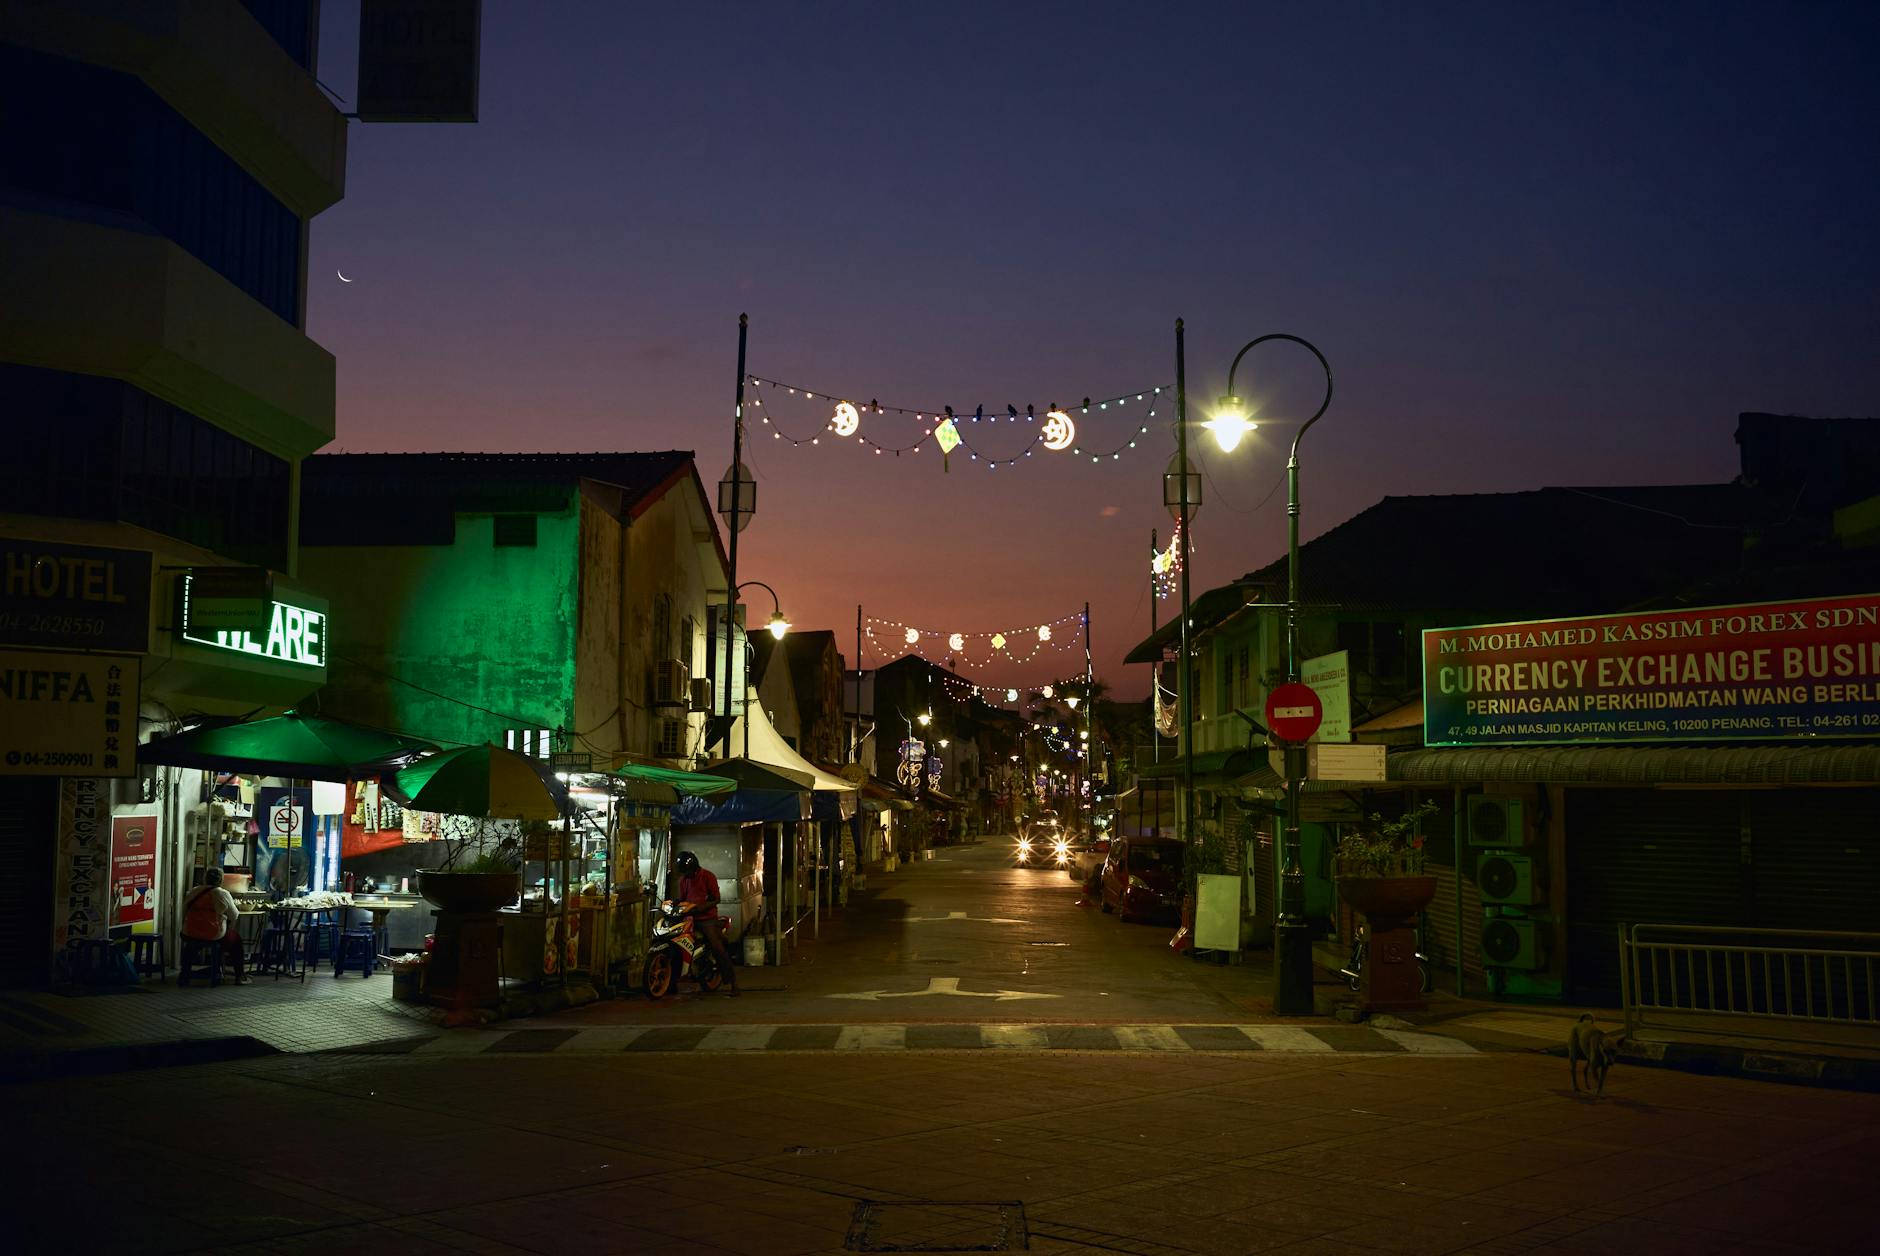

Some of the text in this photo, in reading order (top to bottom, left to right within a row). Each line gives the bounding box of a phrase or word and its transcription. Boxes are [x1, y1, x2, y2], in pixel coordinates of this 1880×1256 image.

[5, 552, 128, 606] HOTEL
[265, 603, 320, 665] ARE
[1602, 619, 1703, 643] KASSIM
[1710, 611, 1808, 636] FOREX
[1815, 606, 1879, 629] SDN
[1440, 658, 1588, 694] CURRENCY
[1598, 648, 1772, 687] EXCHANGE
[1466, 695, 1579, 716] PERNIAGAAN
[1584, 688, 1737, 711] PERKHIDMATAN
[1742, 685, 1808, 705] WANG
[1465, 725, 1478, 736] 49
[1479, 723, 1516, 735] JALAN
[1518, 723, 1562, 735] MASJID
[1564, 721, 1616, 733] KAPITAN
[1618, 720, 1670, 732] KELING,
[1672, 719, 1709, 730] 10200
[1777, 716, 1810, 728] TEL:
[1813, 715, 1858, 727] 04-261
